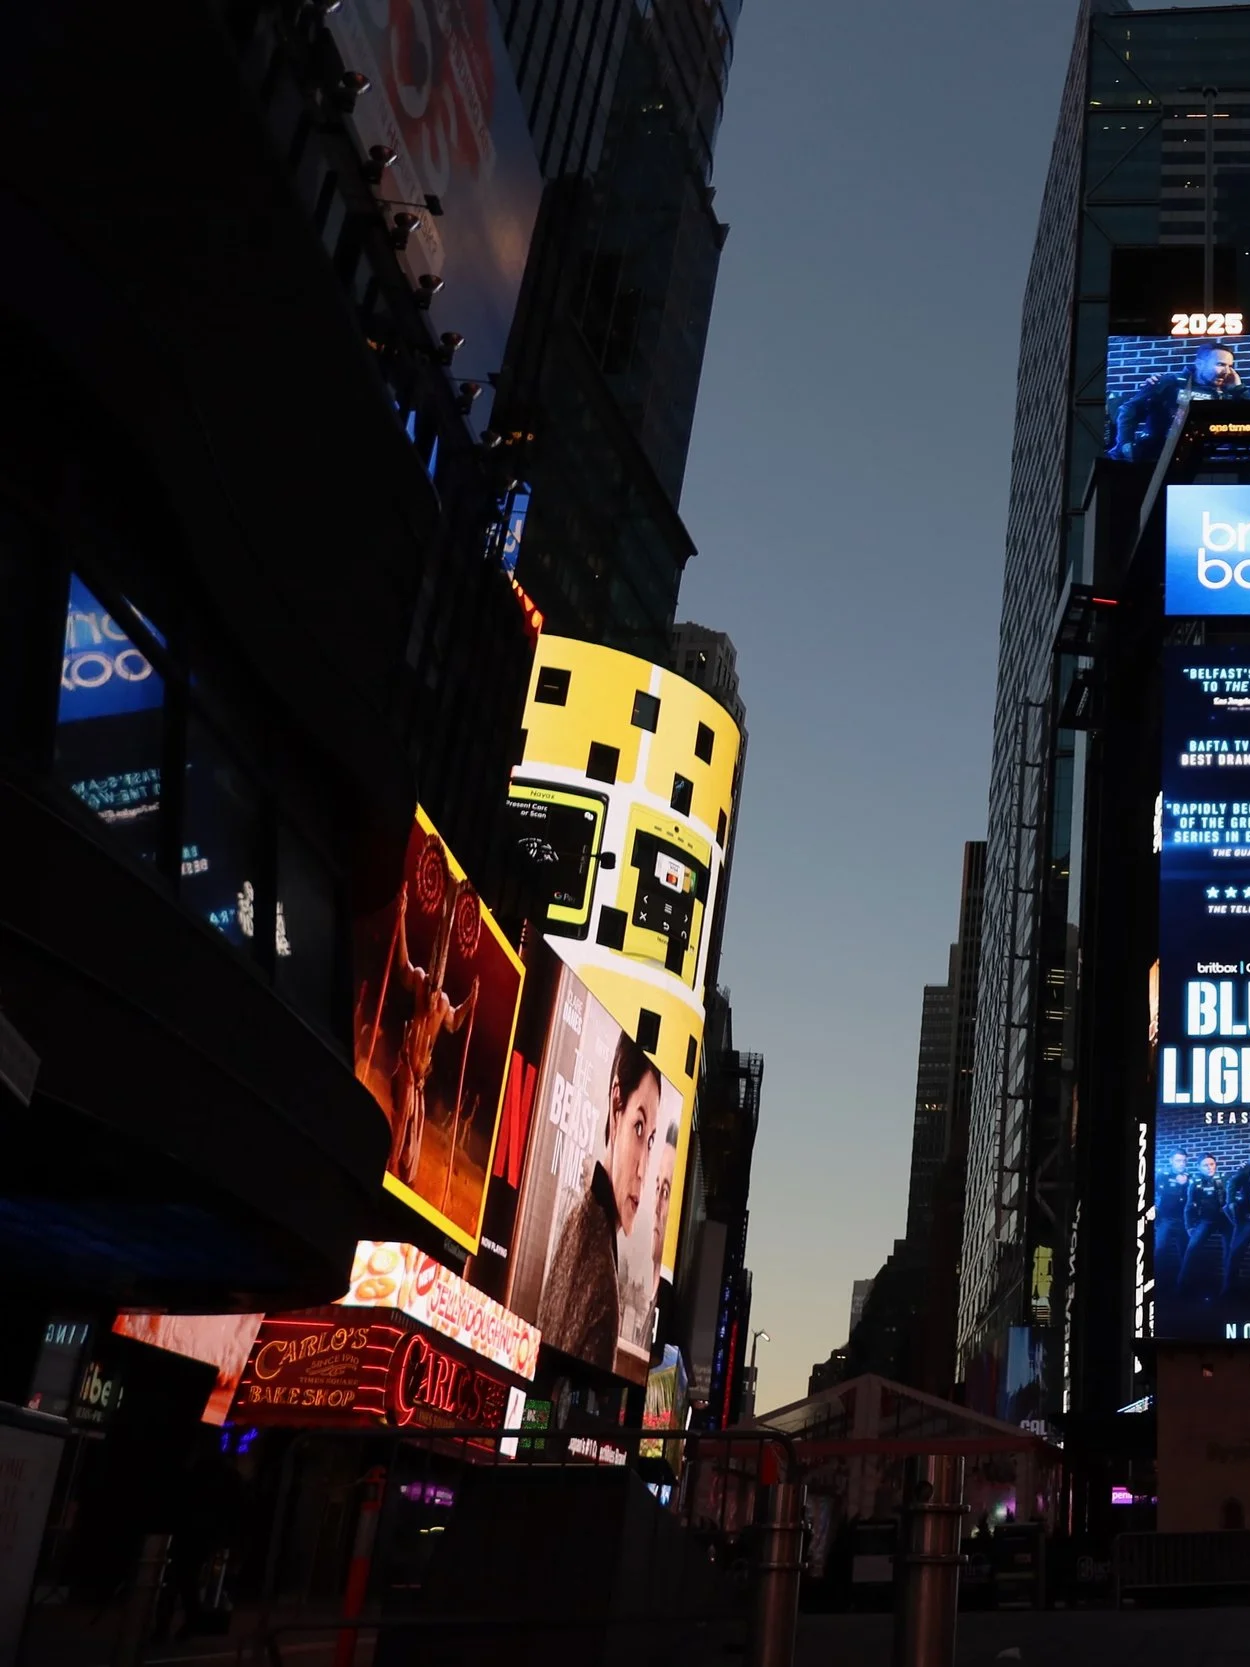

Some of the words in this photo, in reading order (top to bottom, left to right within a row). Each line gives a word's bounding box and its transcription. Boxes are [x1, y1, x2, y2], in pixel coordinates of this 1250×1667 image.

[1171, 313, 1243, 334] 2025
[1209, 424, 1228, 432] one
[1203, 681, 1218, 692] TO
[1225, 681, 1249, 692] THE
[1189, 740, 1228, 751] BAFTA
[1234, 740, 1249, 751] TV
[1181, 754, 1212, 766] BEST
[1166, 803, 1226, 815] "RAPIDLY
[530, 811, 547, 819] Scan
[1180, 817, 1195, 828] OF
[1202, 817, 1224, 828] THE
[1174, 831, 1219, 842] SERIES
[1226, 831, 1239, 842] IN
[1208, 905, 1226, 913] THE
[1197, 962, 1237, 973] britbox
[550, 1072, 599, 1153] BEAST
[431, 1283, 466, 1327] JELLY
[465, 1302, 521, 1356] DOUGHNUT
[255, 1327, 369, 1380] CARLO'S
[250, 1385, 300, 1405] BAKE
[302, 1388, 355, 1408] SHOP
